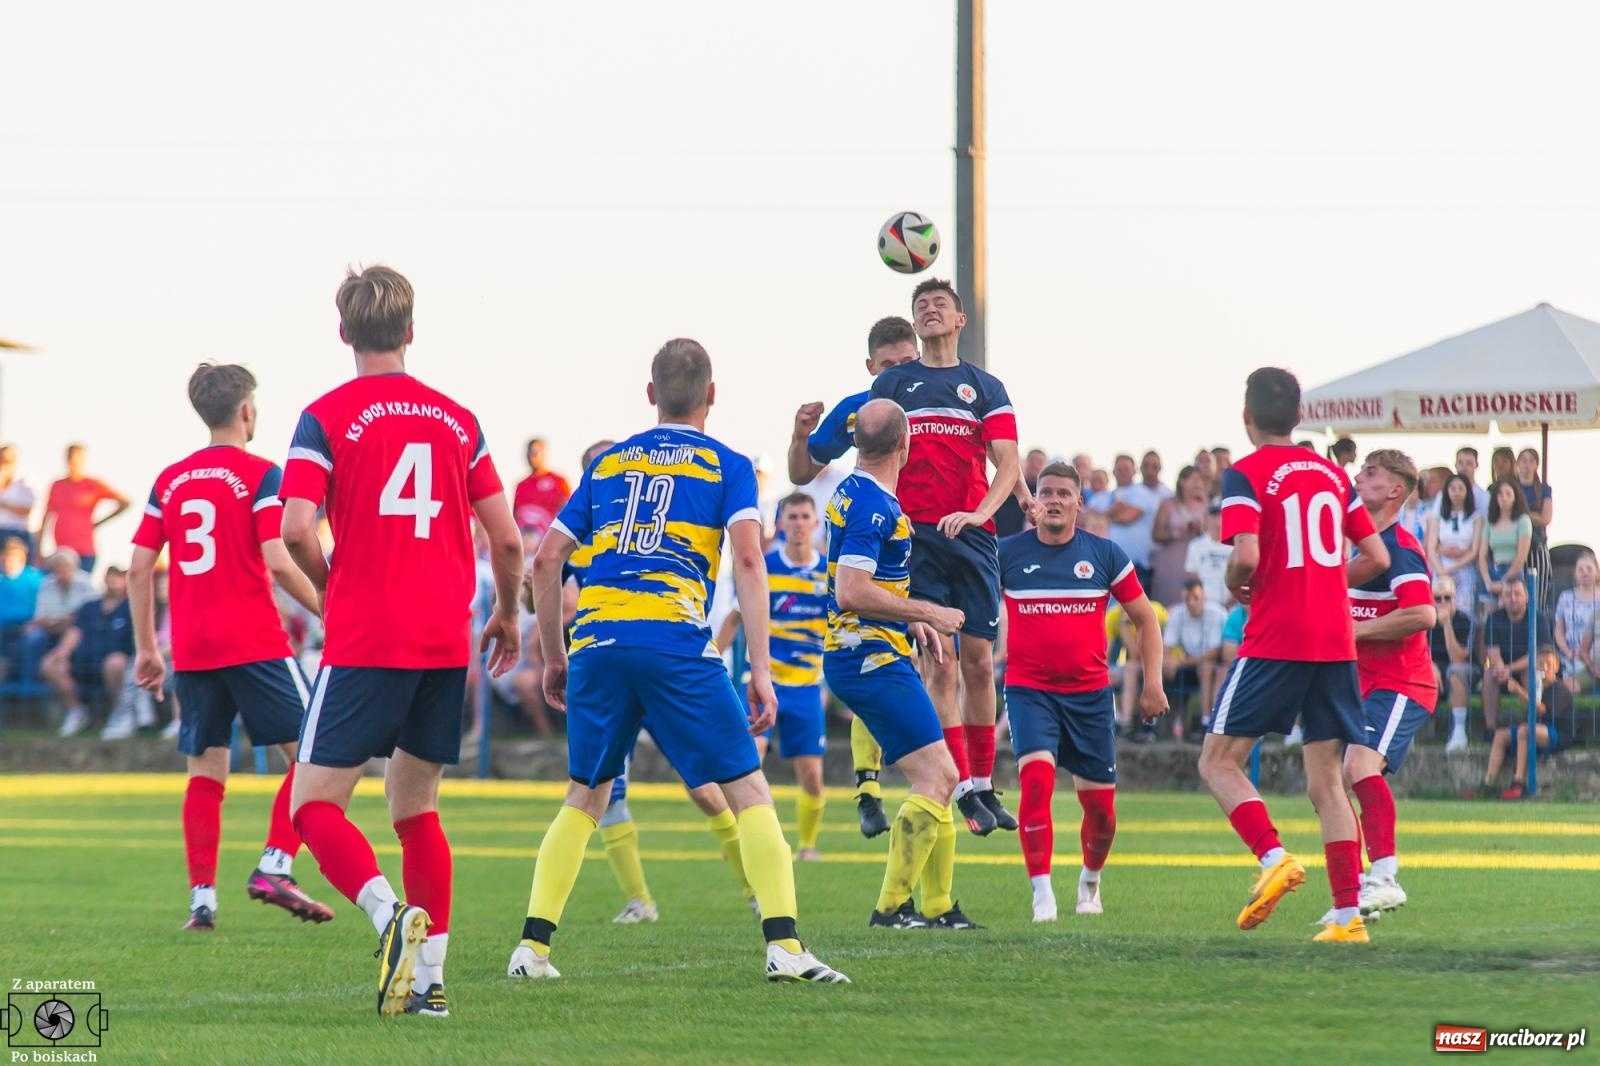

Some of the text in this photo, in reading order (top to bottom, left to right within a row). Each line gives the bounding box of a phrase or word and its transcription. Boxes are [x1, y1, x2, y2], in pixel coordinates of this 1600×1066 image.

[345, 401, 470, 447] KS 1905 KRZANOWICE
[1418, 391, 1578, 417] RACIBORSKIE
[379, 442, 444, 540] 4
[619, 446, 644, 464] LHS
[179, 498, 216, 576] 3
[617, 470, 675, 555] 13
[1281, 491, 1344, 569] 10
